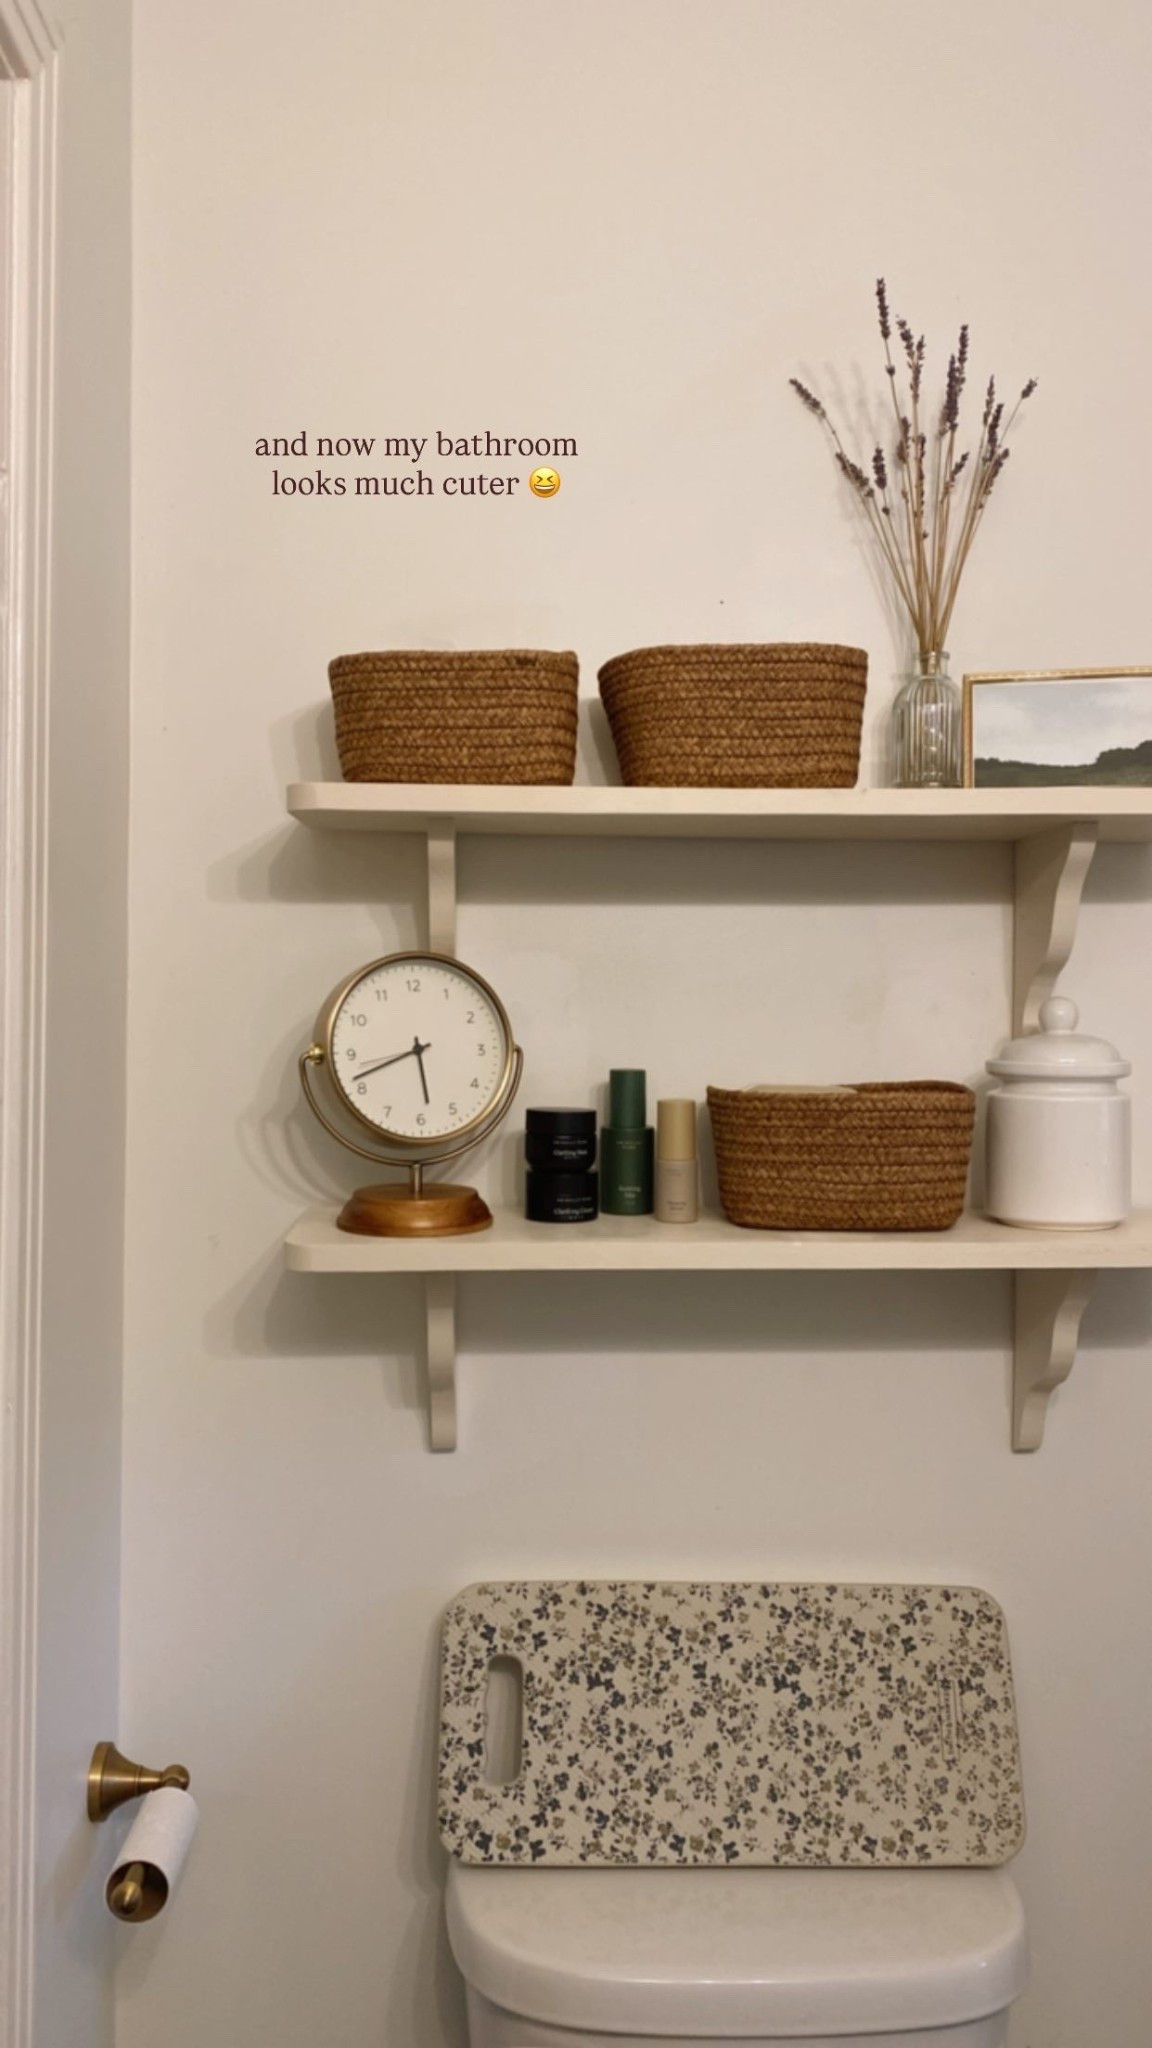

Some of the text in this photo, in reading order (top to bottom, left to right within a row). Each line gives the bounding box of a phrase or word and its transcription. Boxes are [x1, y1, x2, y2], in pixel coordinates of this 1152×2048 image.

[405, 979, 422, 993] 12
[375, 988, 388, 1001] 11
[443, 988, 449, 1000] 1
[350, 1013, 367, 1027] 10
[466, 1011, 476, 1024] 2
[346, 1049, 356, 1061] 9
[477, 1044, 486, 1057] 3
[357, 1082, 367, 1096] 8
[469, 1077, 480, 1089] 4
[383, 1105, 392, 1118] 7
[448, 1102, 458, 1116] 5
[416, 1113, 426, 1126] 6
